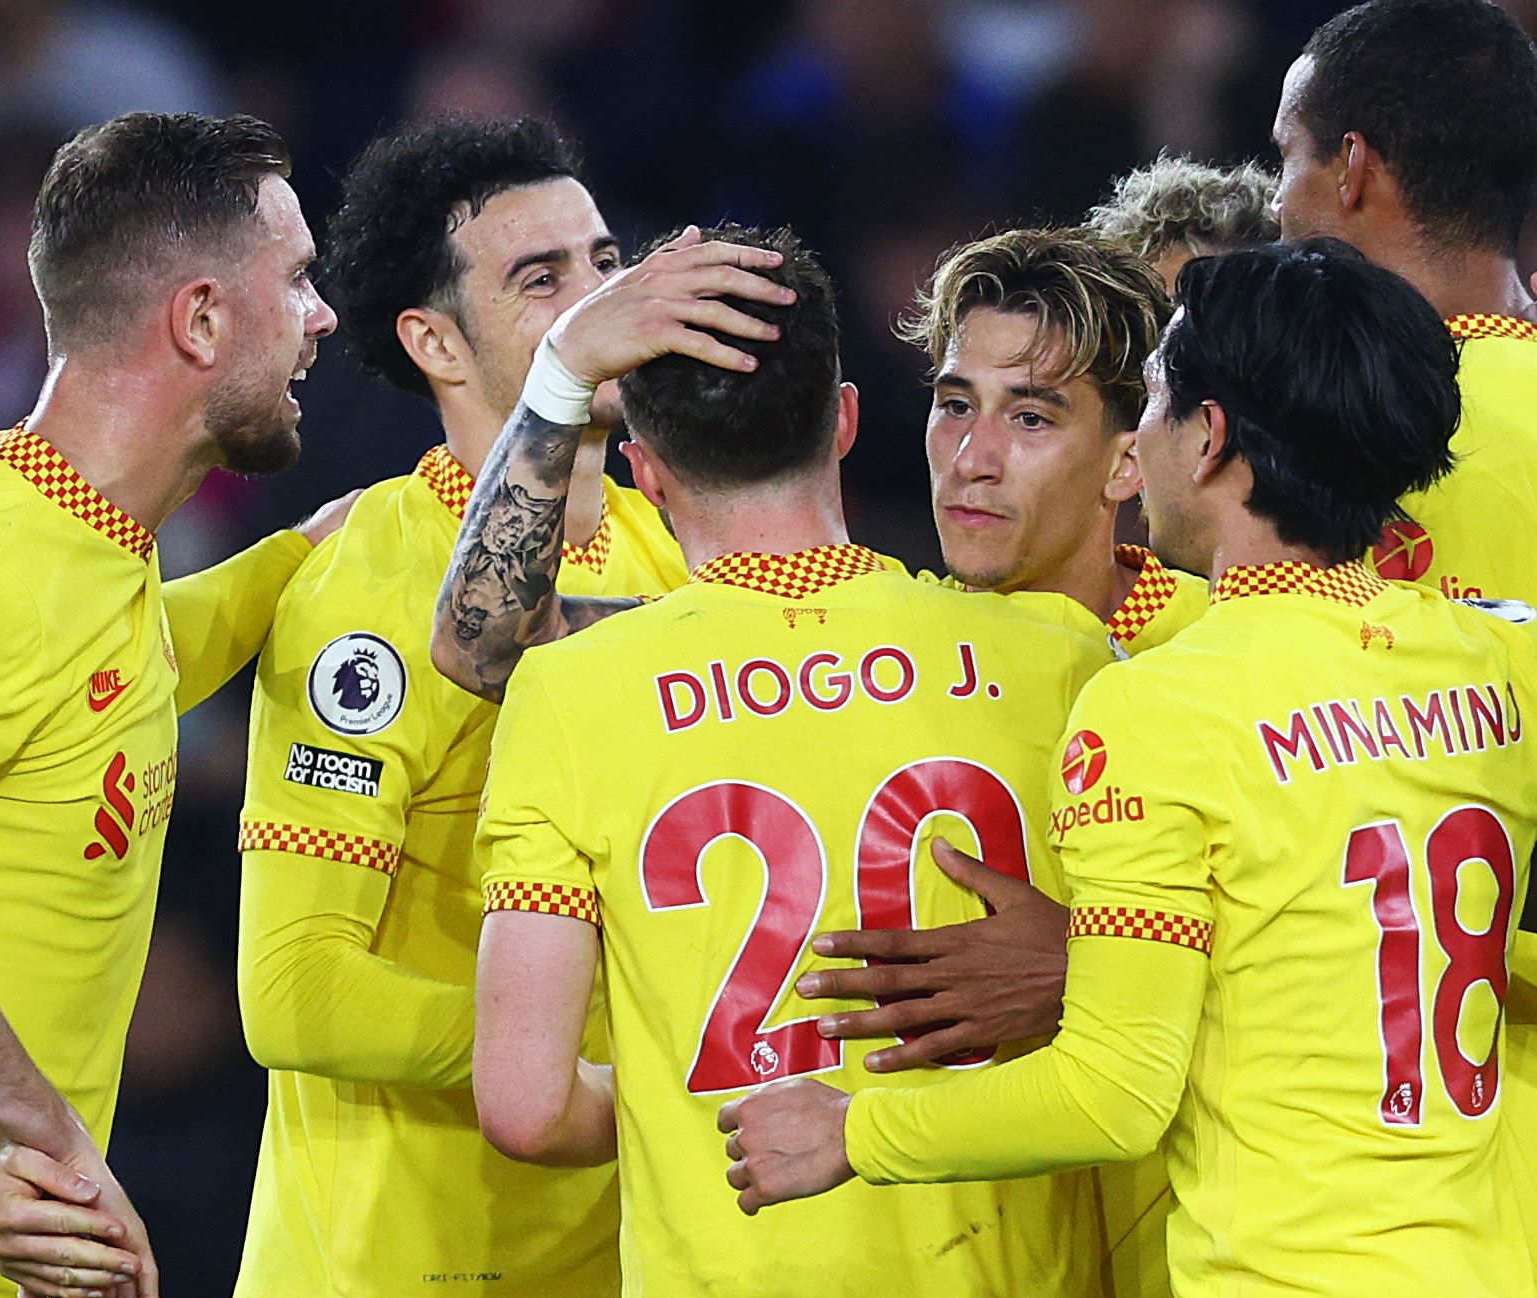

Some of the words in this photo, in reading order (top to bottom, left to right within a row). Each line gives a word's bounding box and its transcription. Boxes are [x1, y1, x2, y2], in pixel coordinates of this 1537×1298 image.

[90, 668, 120, 694] NIKE
[655, 644, 917, 734] DIOGO
[948, 641, 1002, 701] J.
[339, 714, 372, 726] Premier
[372, 692, 394, 721] League
[284, 761, 311, 783] for
[311, 769, 378, 797] racism
[289, 743, 314, 766] No
[316, 752, 372, 778] room
[1047, 785, 1145, 842] xpedia
[639, 755, 1034, 1097] 20
[1341, 802, 1516, 1127] 18
